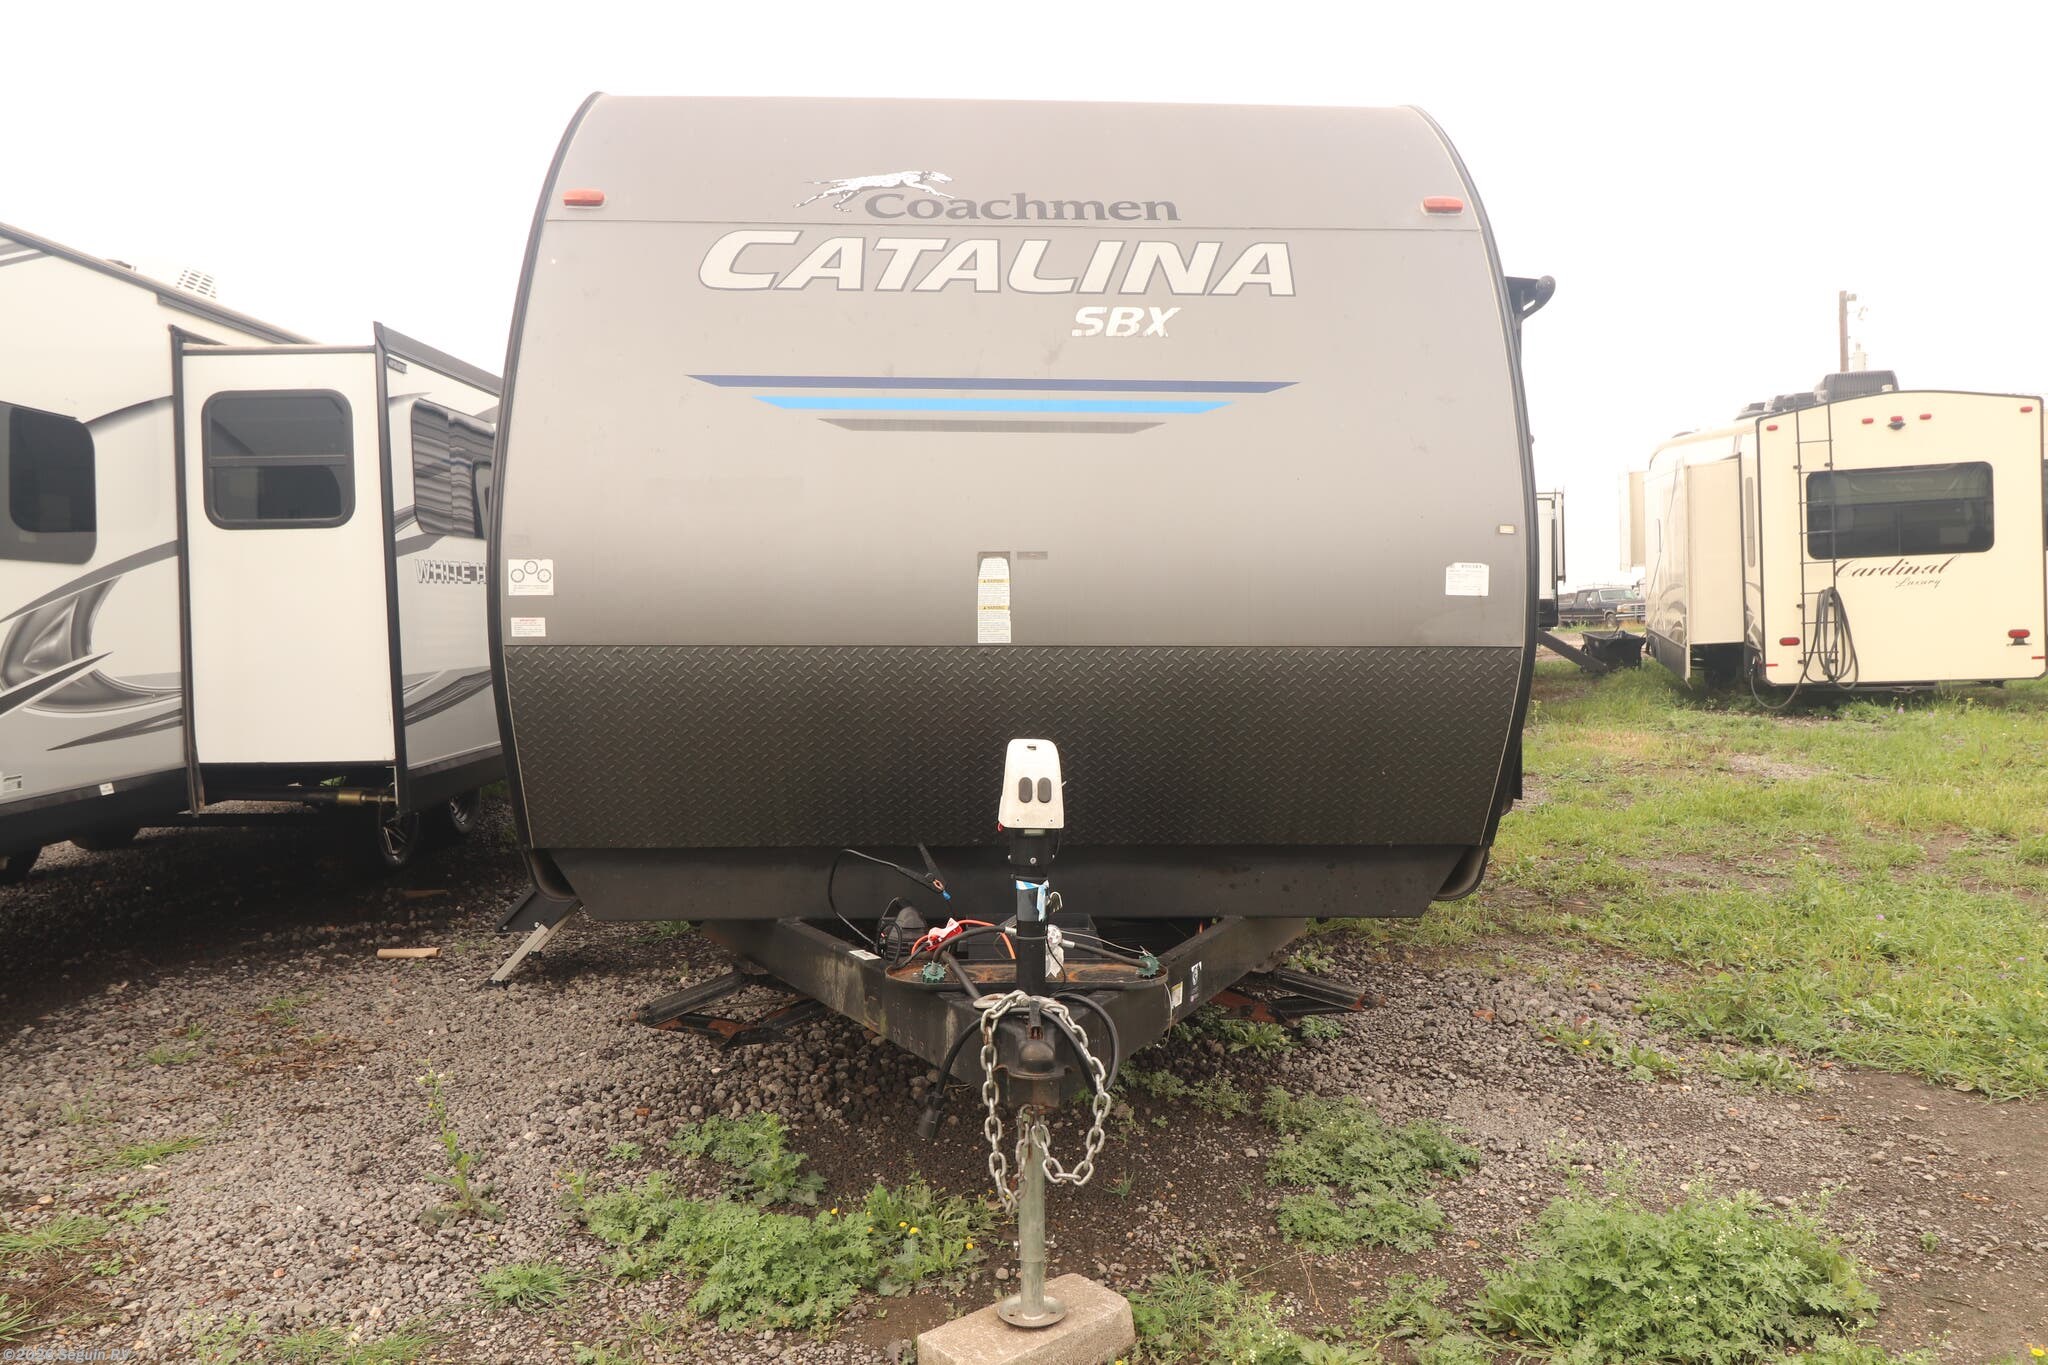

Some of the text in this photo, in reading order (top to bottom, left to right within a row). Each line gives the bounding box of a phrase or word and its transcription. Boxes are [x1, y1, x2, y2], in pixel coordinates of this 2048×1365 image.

[864, 192, 1183, 221] Coachmen
[699, 229, 1297, 298] CATALINA
[1071, 306, 1182, 339] SBX
[416, 559, 471, 584] WHITE
[1835, 554, 1960, 577] Cardinal
